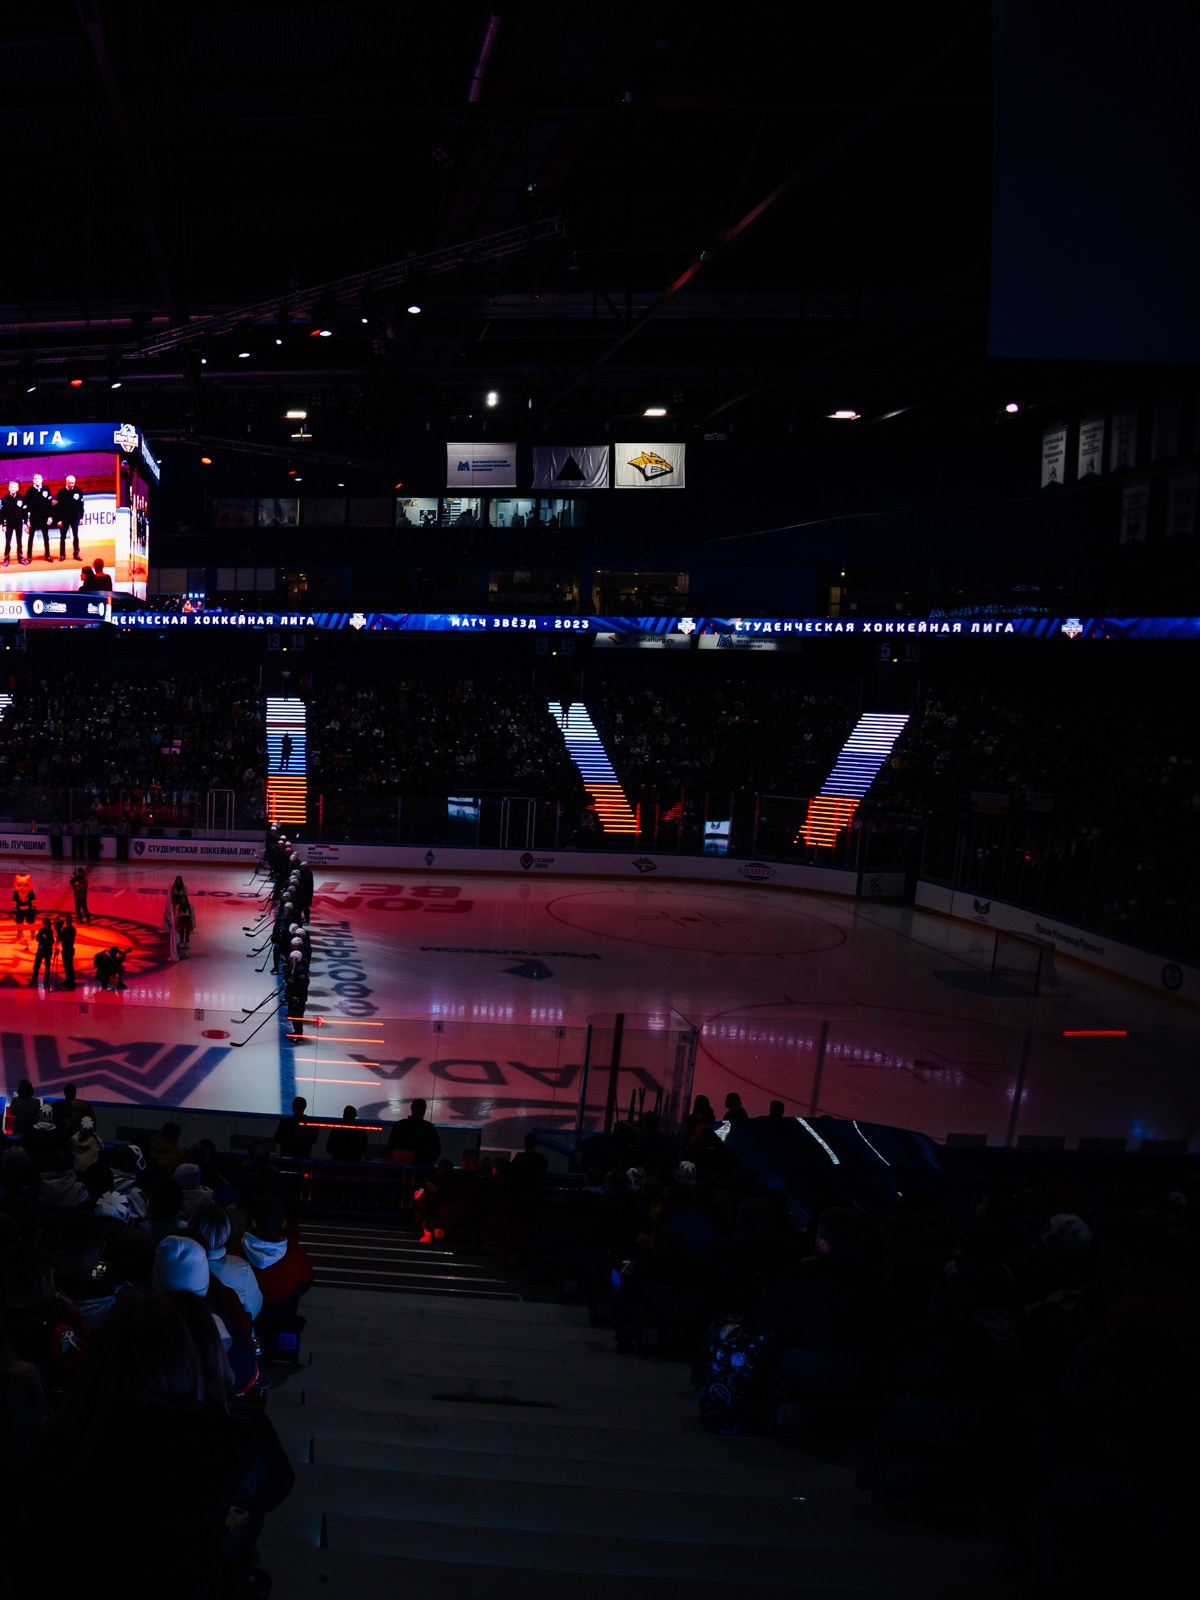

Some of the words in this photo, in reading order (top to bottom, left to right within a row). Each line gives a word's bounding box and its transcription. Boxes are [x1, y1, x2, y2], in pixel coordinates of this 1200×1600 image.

[7, 430, 66, 446] ЛИГА
[84, 511, 116, 525] НЧЕСК
[111, 616, 188, 627] ДЕНЧЕСКАЯ
[194, 614, 274, 626] ХОККЕЙНАЯ
[280, 616, 315, 626] ЛИГА
[451, 616, 487, 627] МАТЧ
[494, 617, 537, 630] ЗВЁЗД
[554, 619, 589, 629] 2023
[735, 619, 855, 632] СТУДЕНЧЕСКАЯ
[863, 620, 962, 633] ХОККЕЙНАЯ
[970, 622, 1014, 633] ЛИГА
[292, 634, 305, 648] 14
[11, 841, 46, 851] ЛУЧШИМ!
[148, 845, 198, 856] СТУДЕНЧЕСКАЯ
[199, 845, 238, 857] ХОККЕЙНАЯ
[347, 1052, 664, 1093] LADA
[281, 1336, 295, 1348] 12
